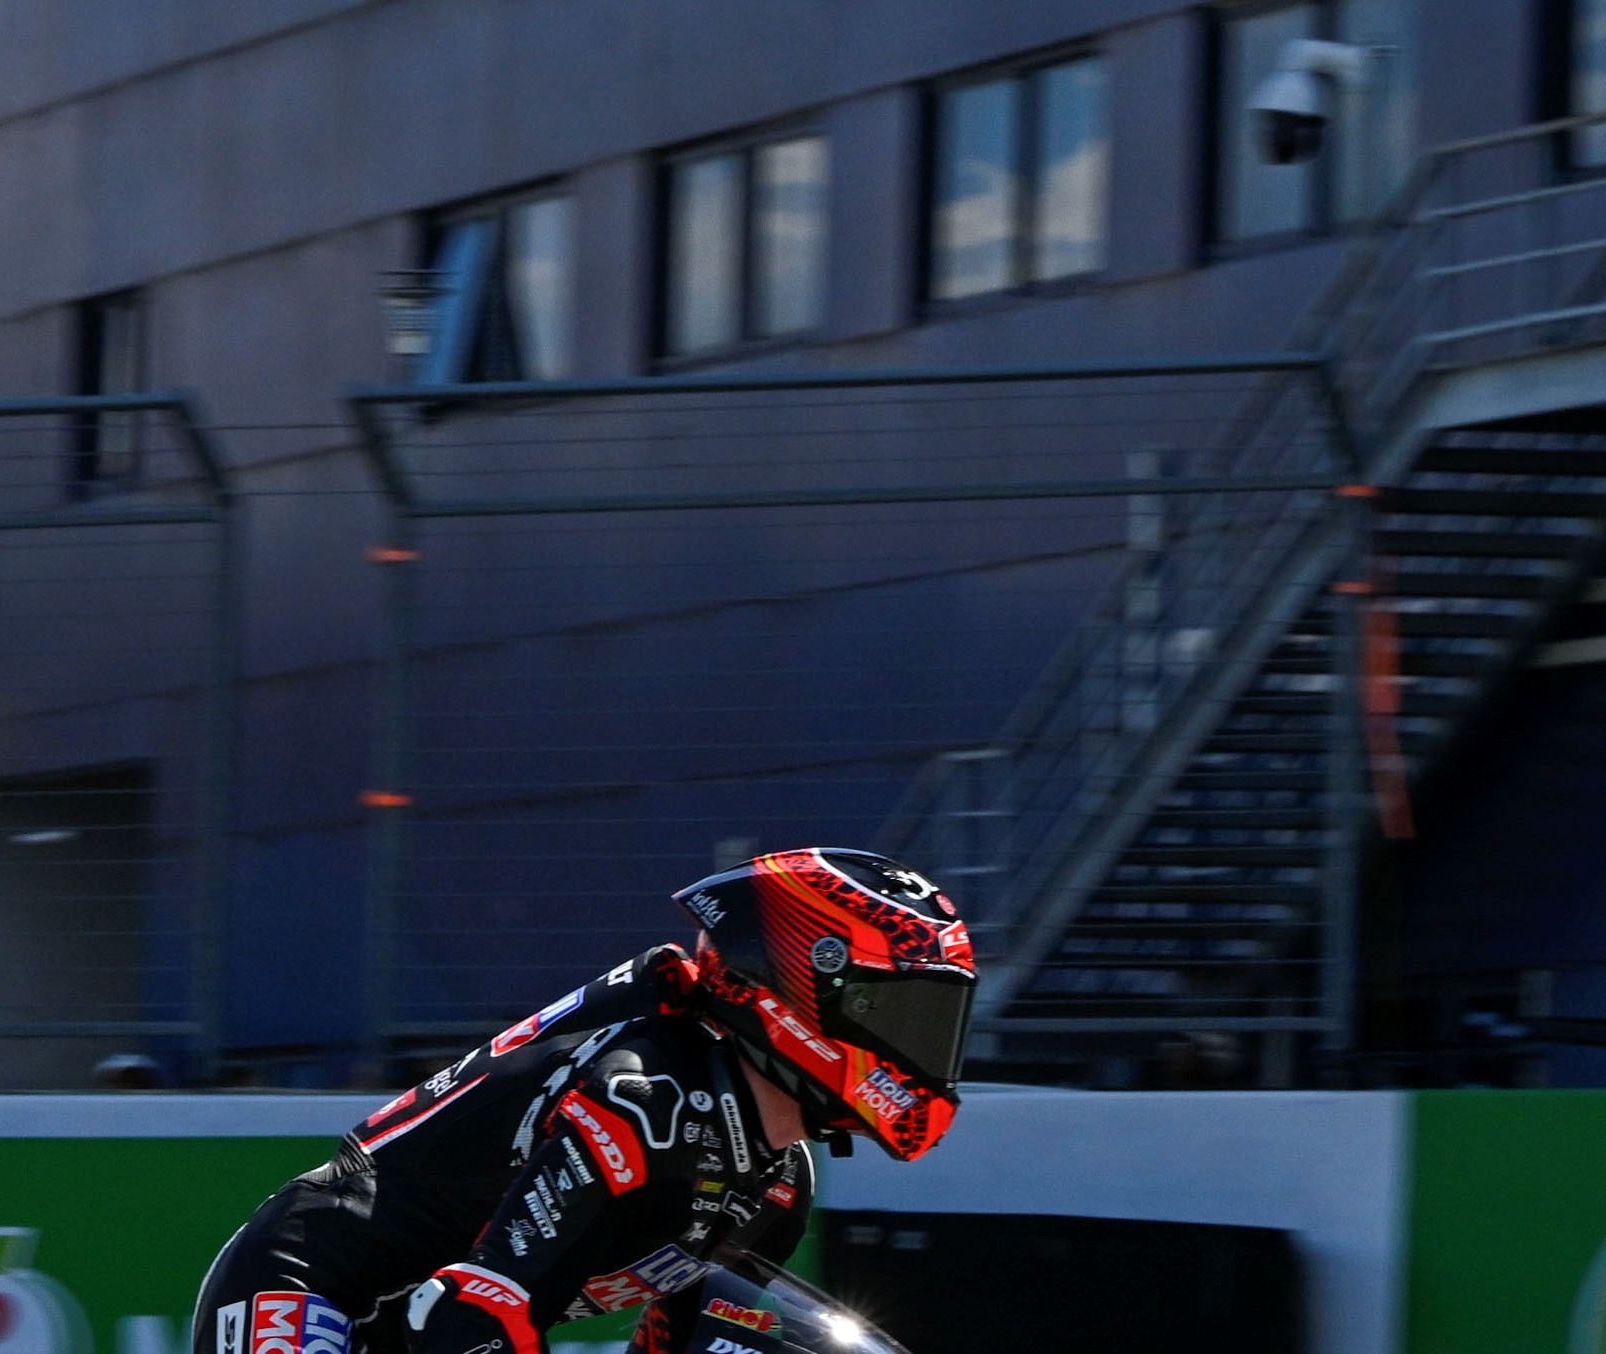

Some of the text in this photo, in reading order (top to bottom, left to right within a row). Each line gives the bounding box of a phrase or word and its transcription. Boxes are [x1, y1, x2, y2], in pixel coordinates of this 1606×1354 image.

[757, 998, 843, 1064] LS2
[854, 1081, 903, 1120] MOLY
[871, 1066, 917, 1108] LIQUI
